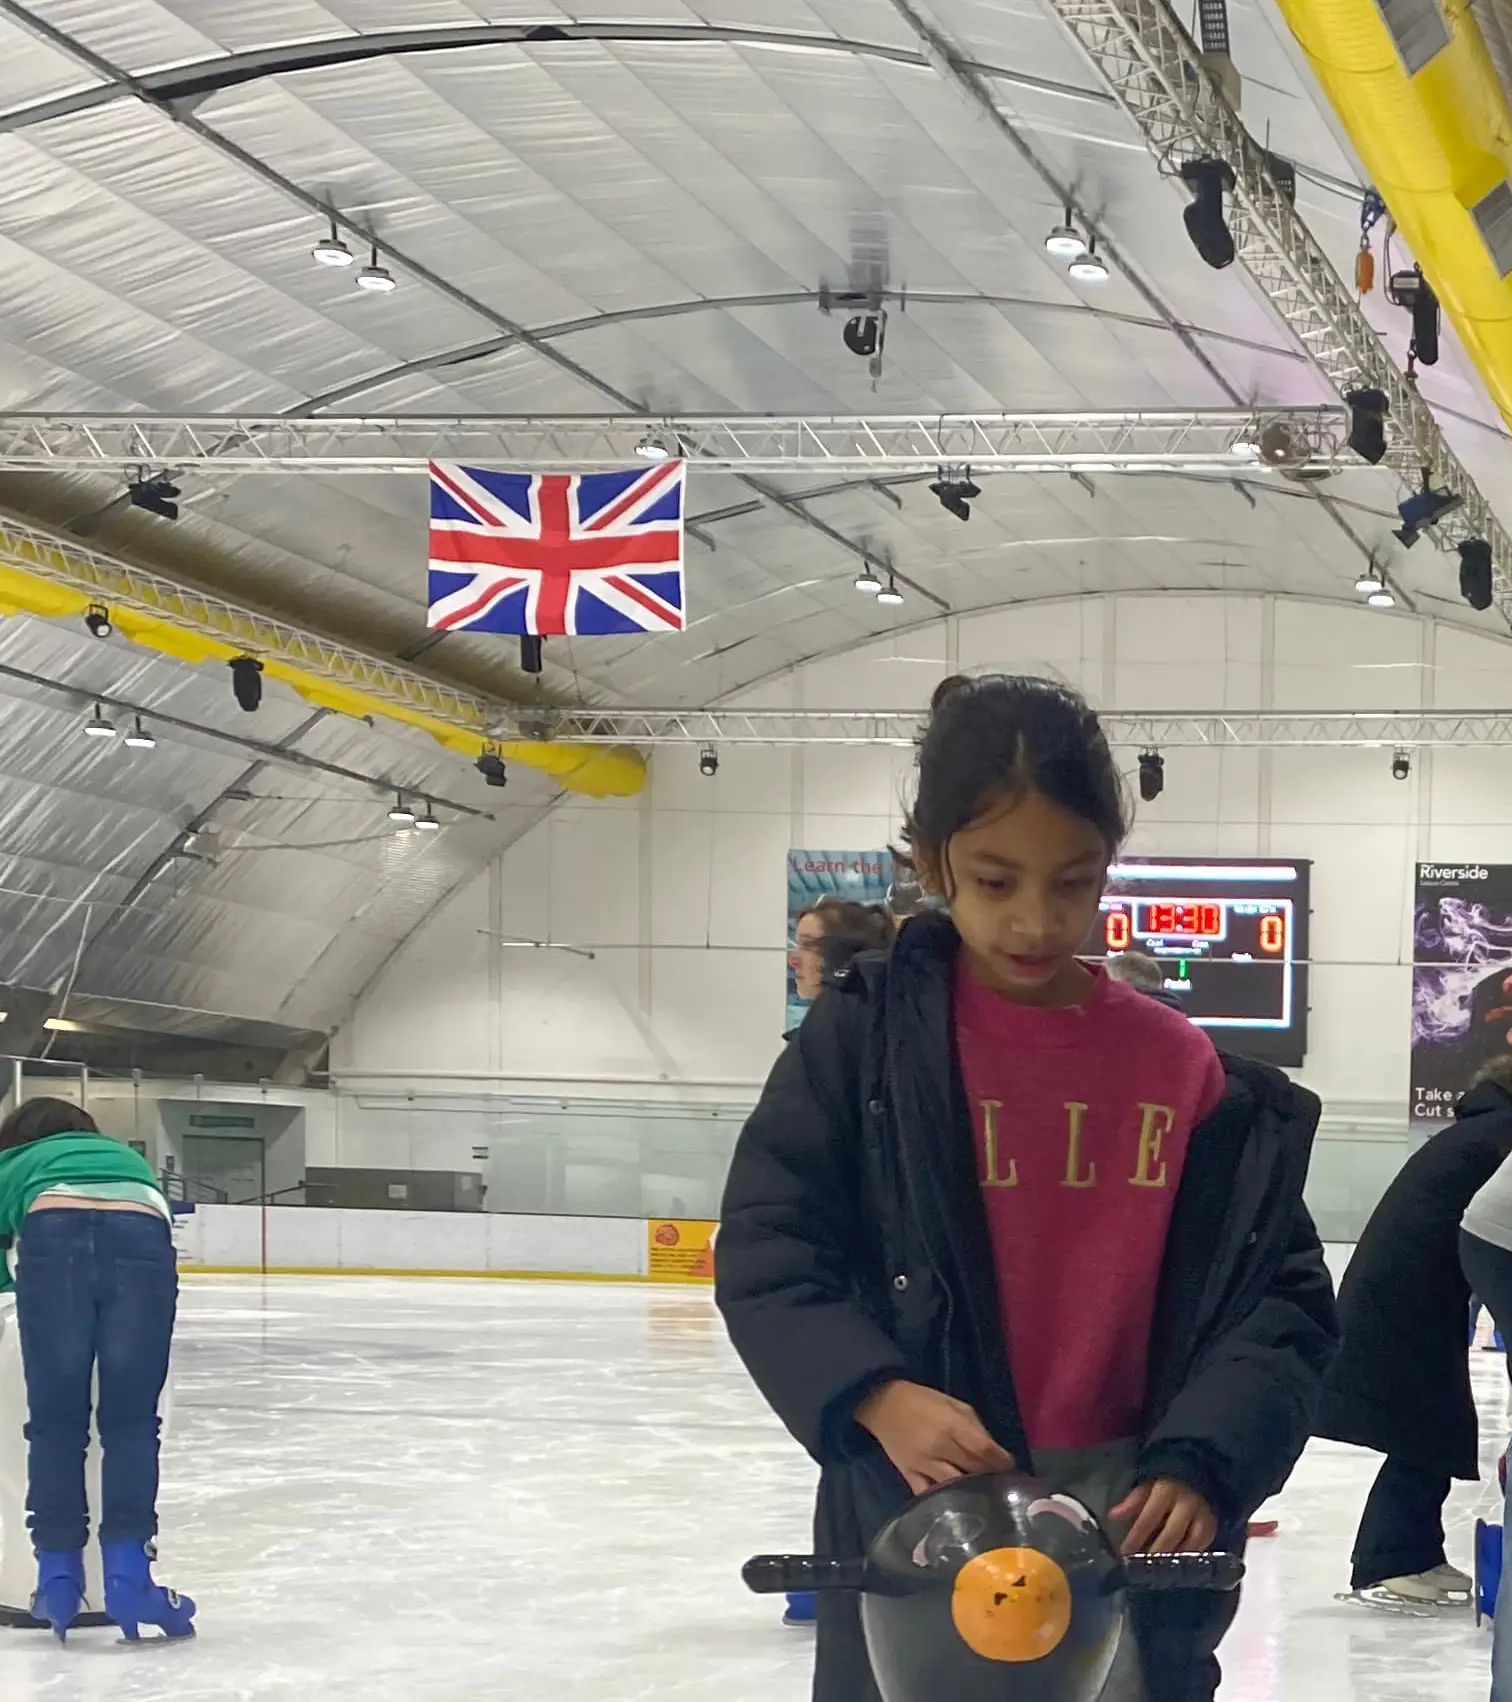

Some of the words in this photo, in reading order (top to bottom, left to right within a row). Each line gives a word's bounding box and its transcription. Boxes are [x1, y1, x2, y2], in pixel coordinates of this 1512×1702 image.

[794, 856, 845, 873] Learn
[852, 858, 883, 874] the
[1419, 863, 1489, 880] Riverside
[1106, 912, 1130, 949] 0
[1149, 903, 1221, 934] 13:30
[1260, 915, 1284, 951] 0
[1415, 1087, 1453, 1101] Take
[1414, 1103, 1442, 1117] Cut
[1446, 1106, 1455, 1118] s
[979, 1099, 1176, 1188] LLE
